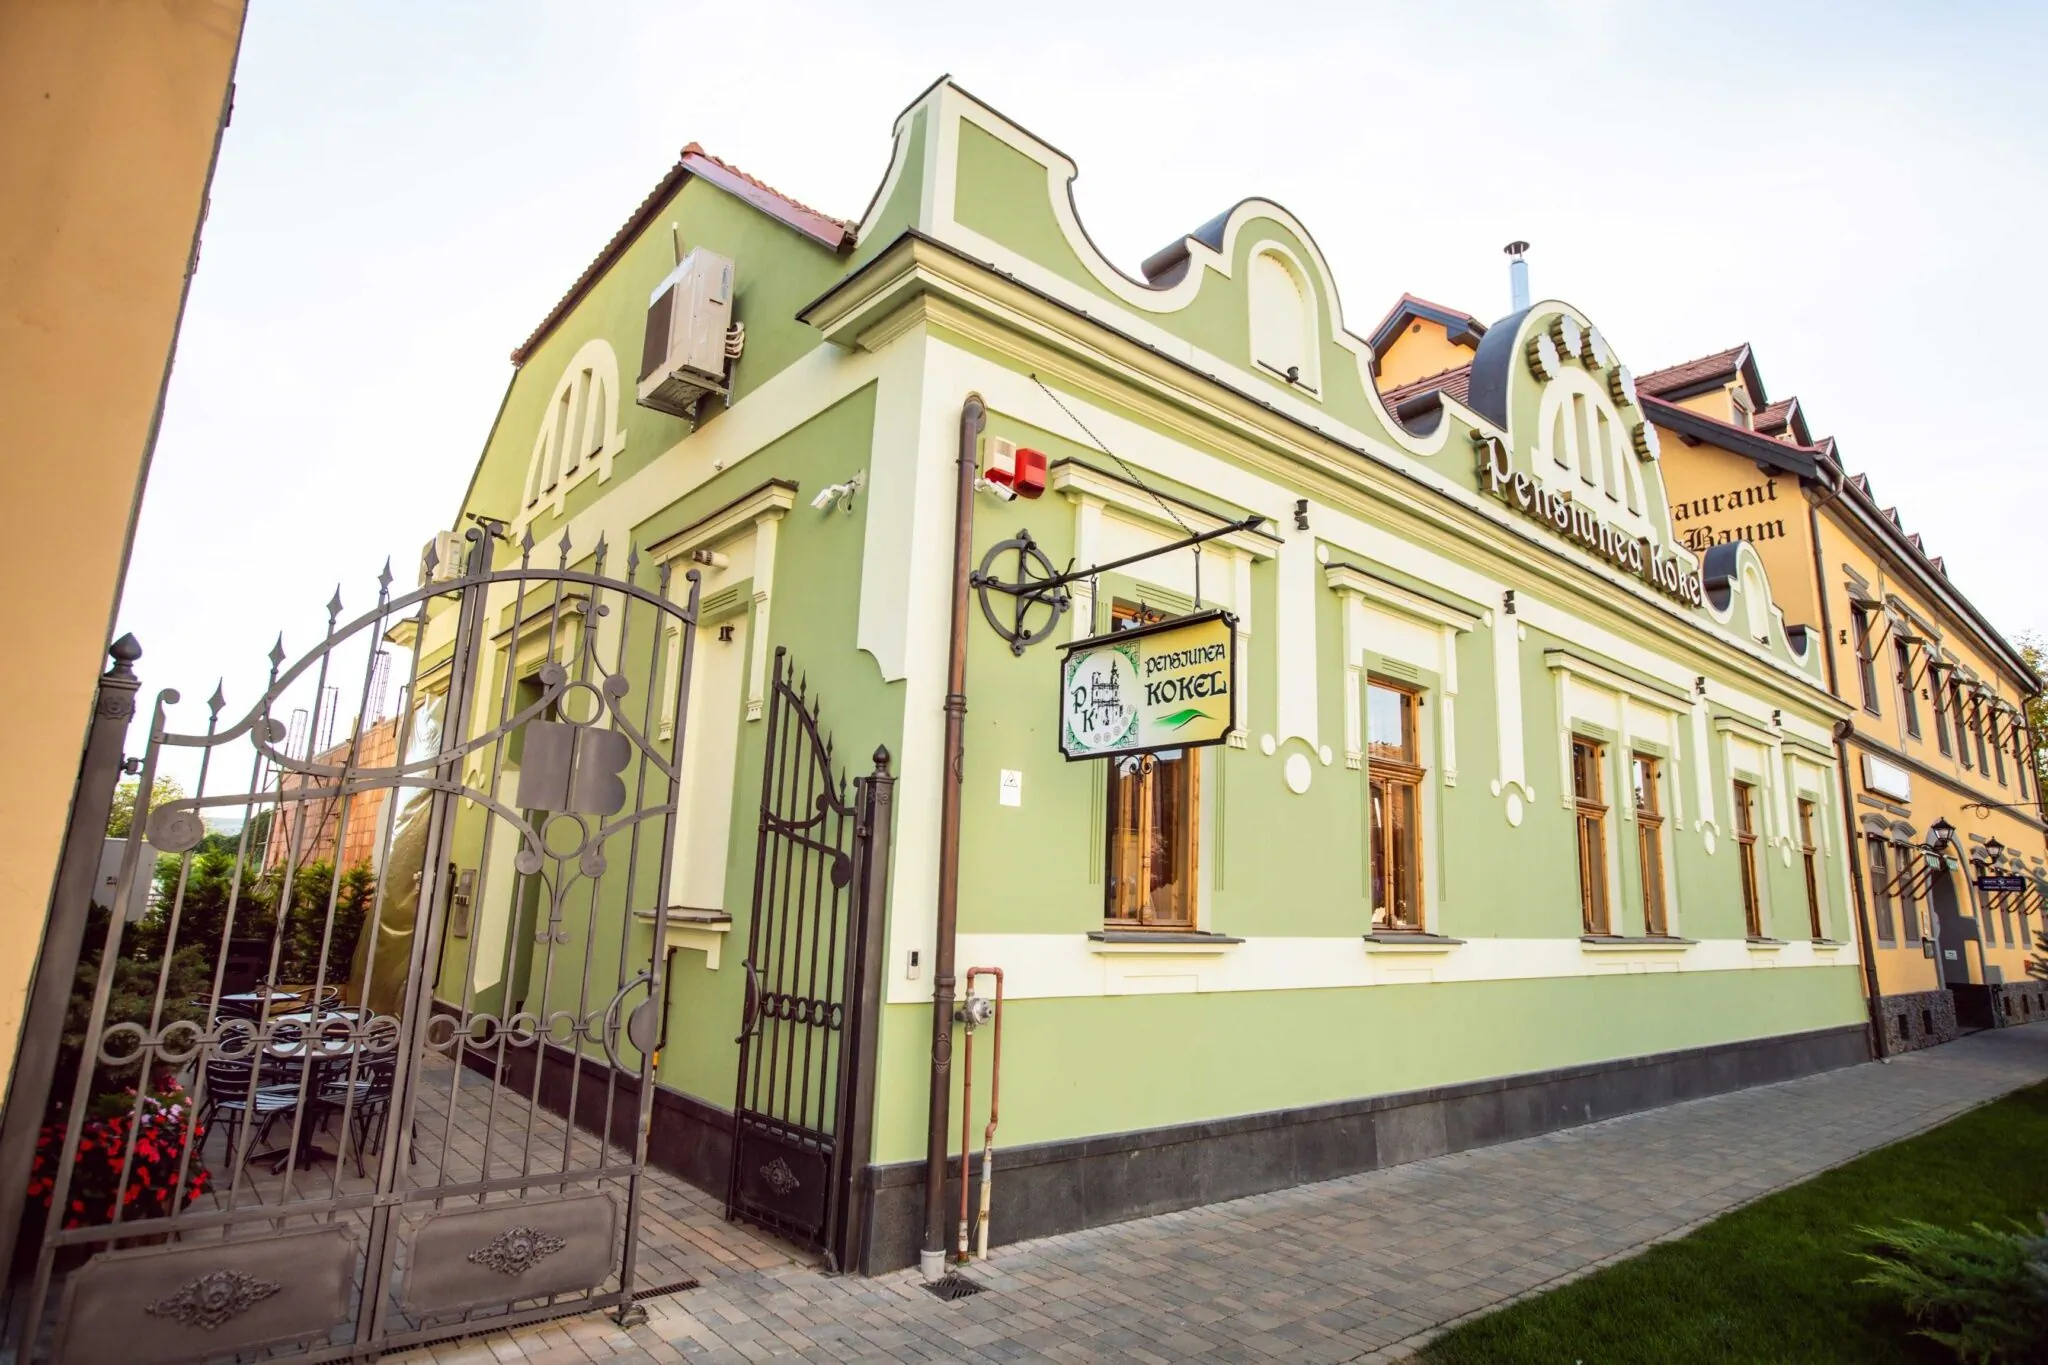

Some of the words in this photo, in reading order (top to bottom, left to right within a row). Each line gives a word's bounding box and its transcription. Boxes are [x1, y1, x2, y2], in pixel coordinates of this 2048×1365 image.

[1478, 430, 1644, 572] Pensiunea
[1669, 479, 1778, 521] aurant
[1682, 519, 1787, 552] Baum
[1145, 642, 1226, 678] PENSIUNEA
[1145, 670, 1227, 706] KOKEL
[1081, 707, 1096, 733] K
